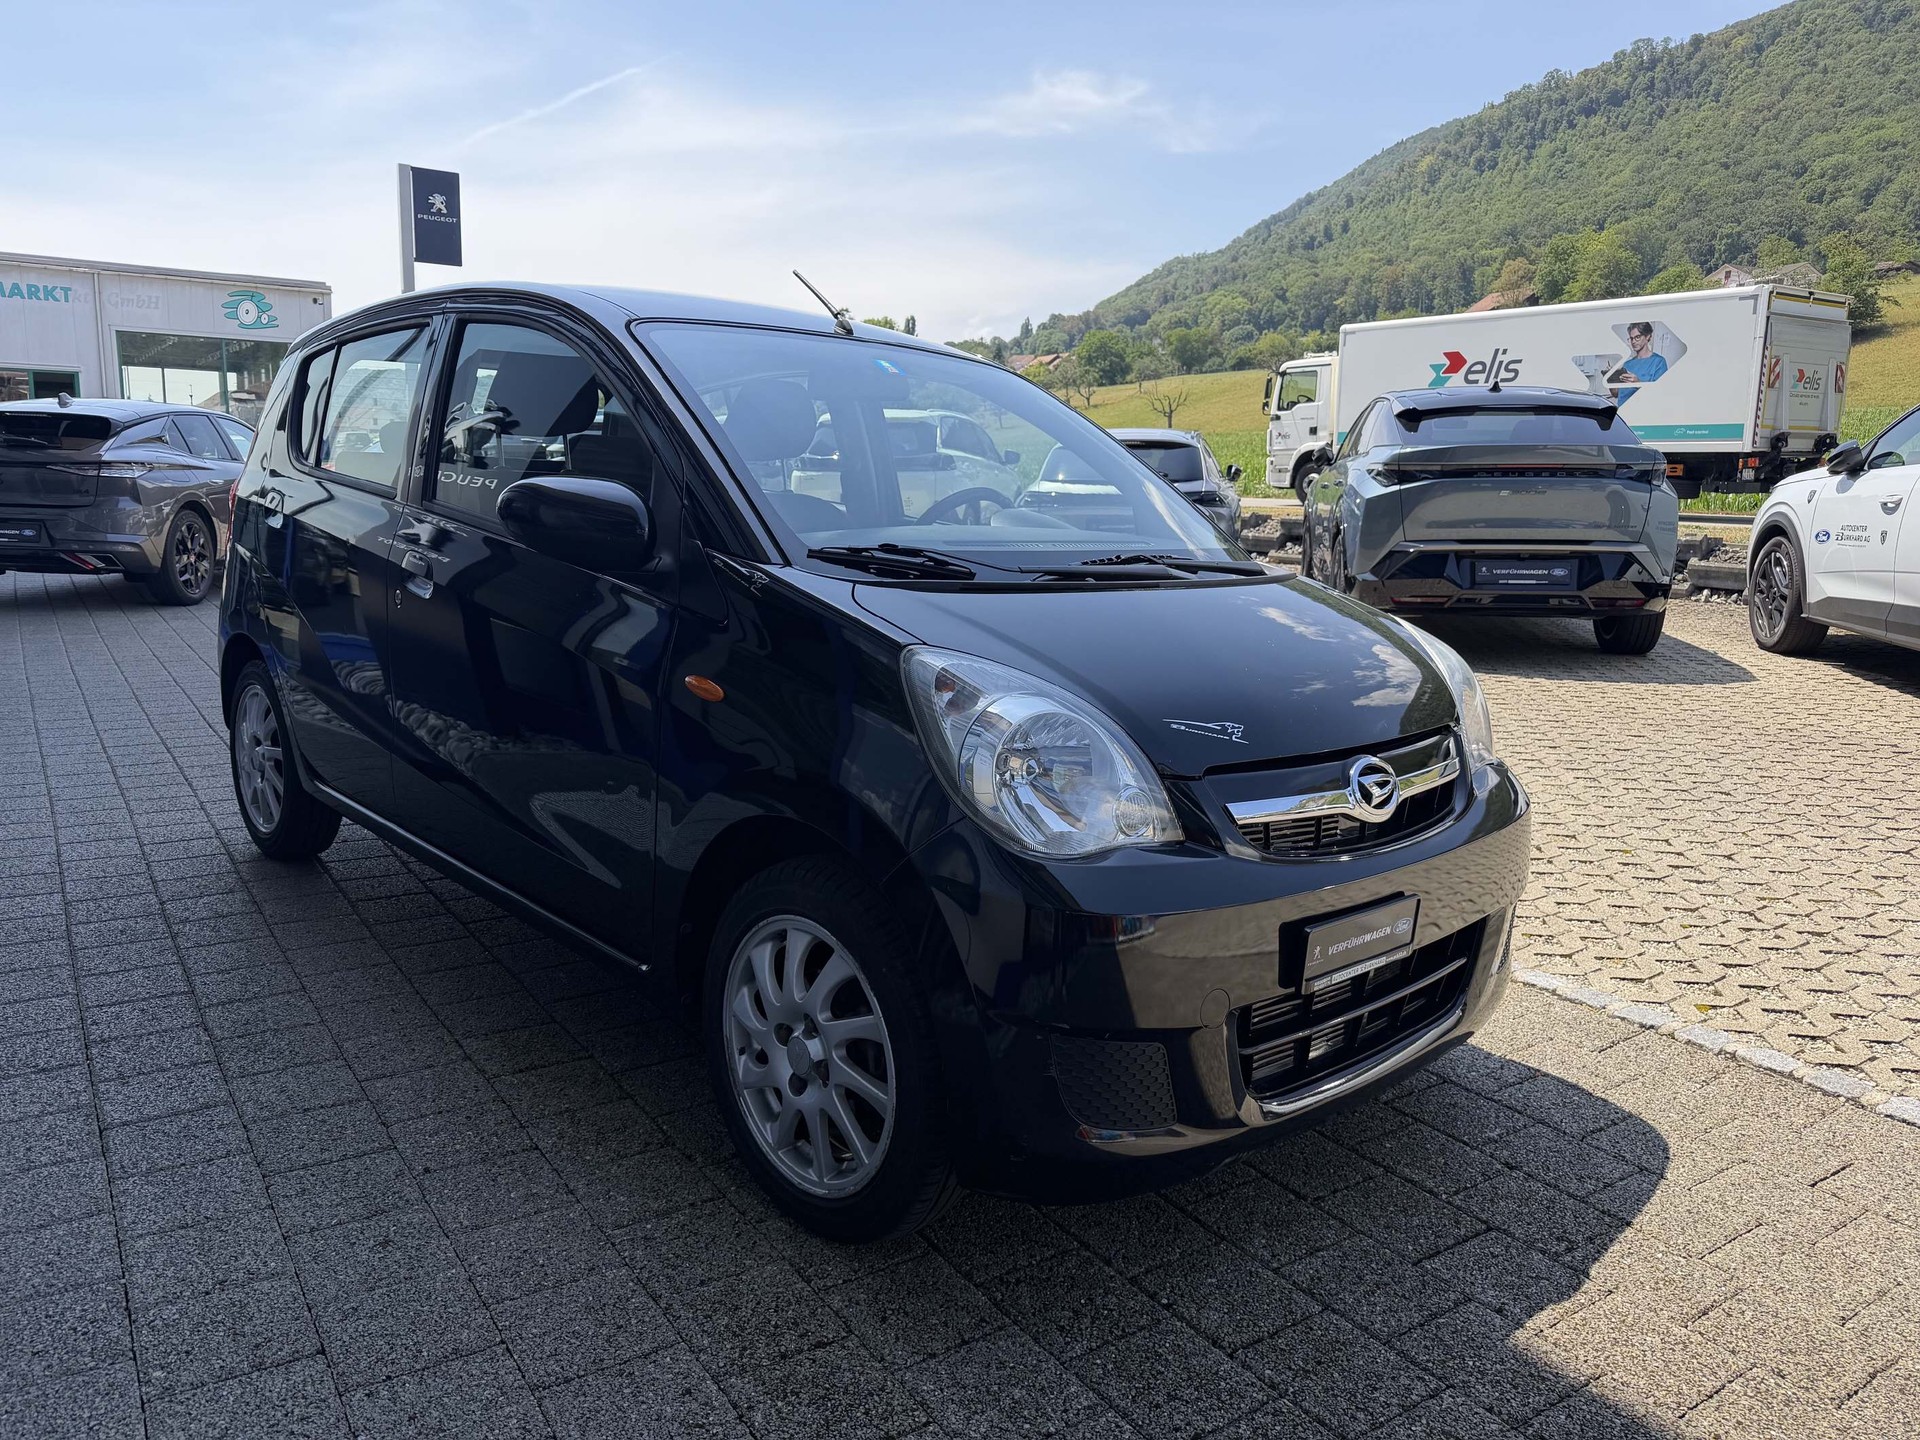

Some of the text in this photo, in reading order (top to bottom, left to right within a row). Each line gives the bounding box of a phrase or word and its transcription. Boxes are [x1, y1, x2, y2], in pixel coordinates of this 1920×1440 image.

[417, 213, 457, 223] PEUGEOT
[1463, 348, 1523, 384] elis
[1802, 369, 1822, 391] elis
[1864, 535, 1871, 543] AG
[1328, 926, 1392, 955] VERFÜHRWAGEN
